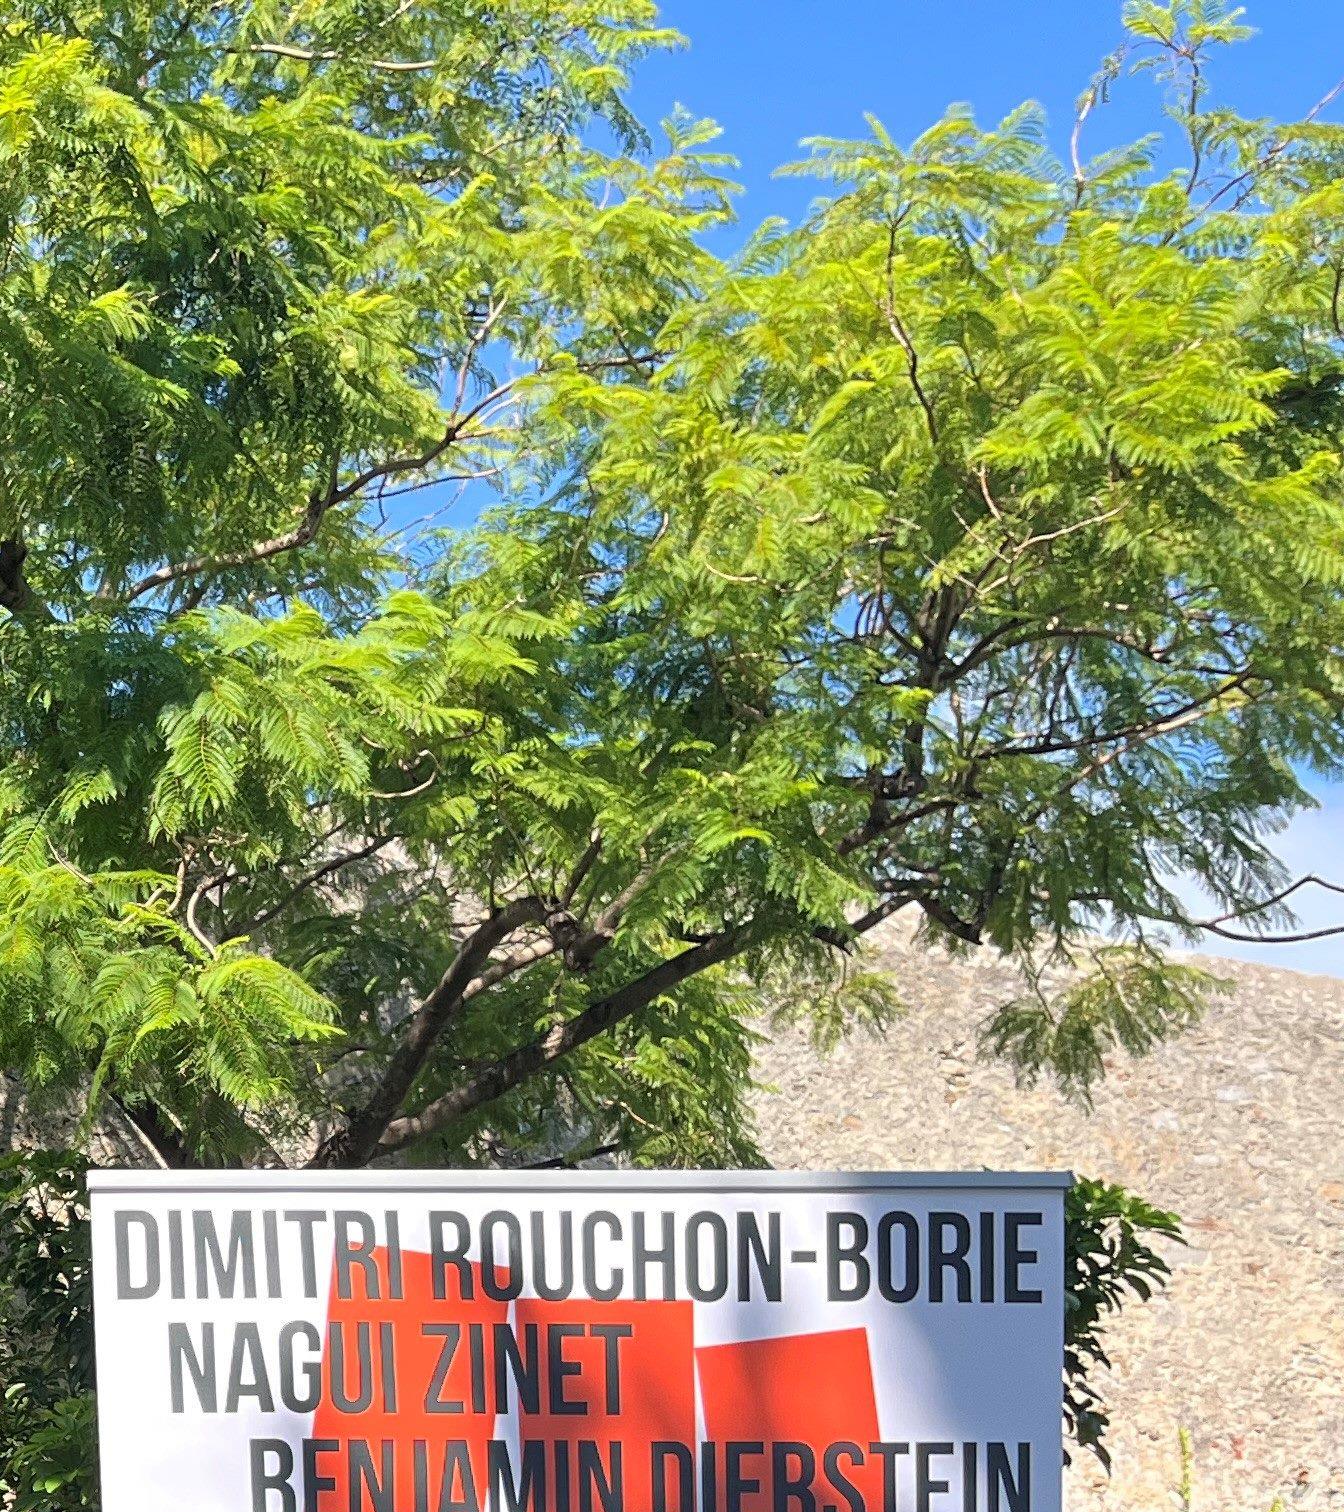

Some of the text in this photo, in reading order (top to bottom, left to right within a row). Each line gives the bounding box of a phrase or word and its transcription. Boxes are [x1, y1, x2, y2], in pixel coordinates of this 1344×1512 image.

[115, 1209, 1043, 1304] DIMITRI ROUCHON-BORIE
[168, 1321, 634, 1415] NAGUI ZINET
